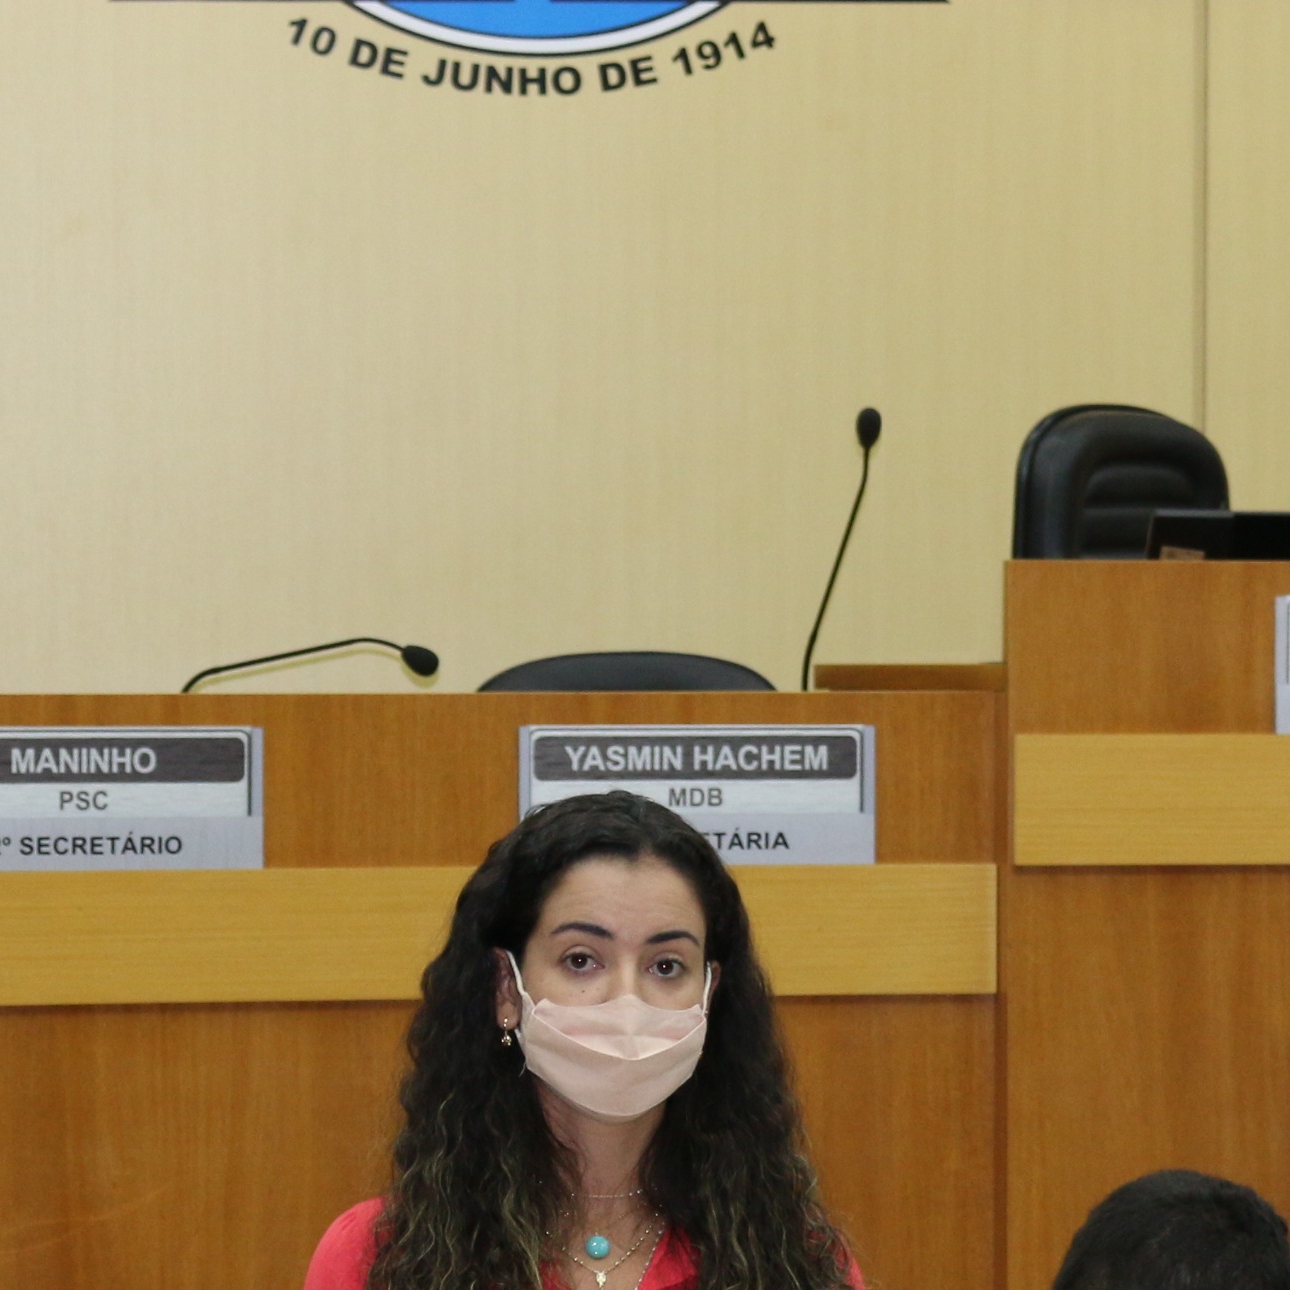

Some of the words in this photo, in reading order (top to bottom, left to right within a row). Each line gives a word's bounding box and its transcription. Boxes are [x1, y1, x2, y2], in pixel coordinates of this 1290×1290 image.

[287, 17, 337, 57] 10
[348, 38, 408, 80] DE
[421, 58, 583, 96] JUNHO
[598, 56, 658, 92] DE
[672, 20, 776, 77] 1914
[10, 747, 157, 774] MANINHO
[564, 745, 684, 772] YASMIN
[693, 745, 829, 772] HACHEM
[59, 791, 109, 812] PSC
[668, 788, 723, 808] MDB
[19, 831, 183, 856] SECRETÁRIO
